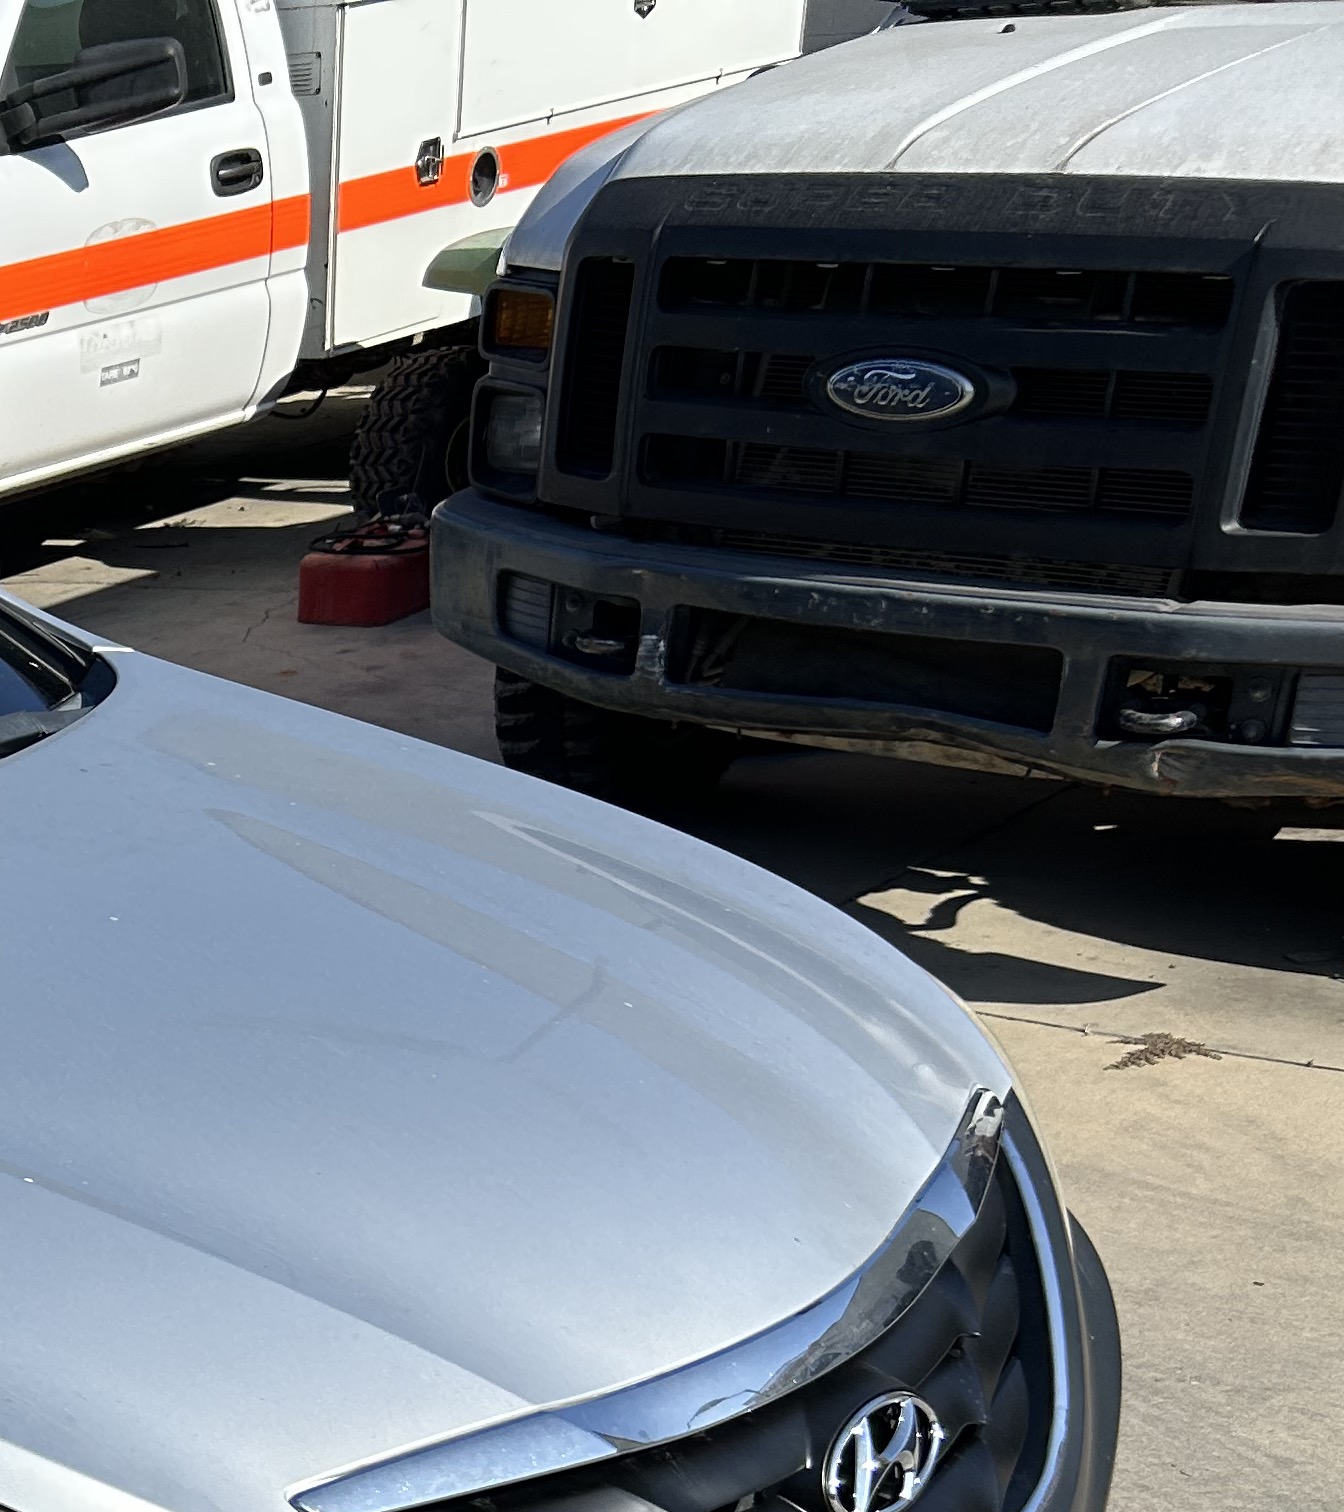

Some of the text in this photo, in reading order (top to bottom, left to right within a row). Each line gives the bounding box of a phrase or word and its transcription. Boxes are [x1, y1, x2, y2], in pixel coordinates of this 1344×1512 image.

[684, 183, 1257, 221] SUPER DUTY
[853, 369, 936, 408] Ford
